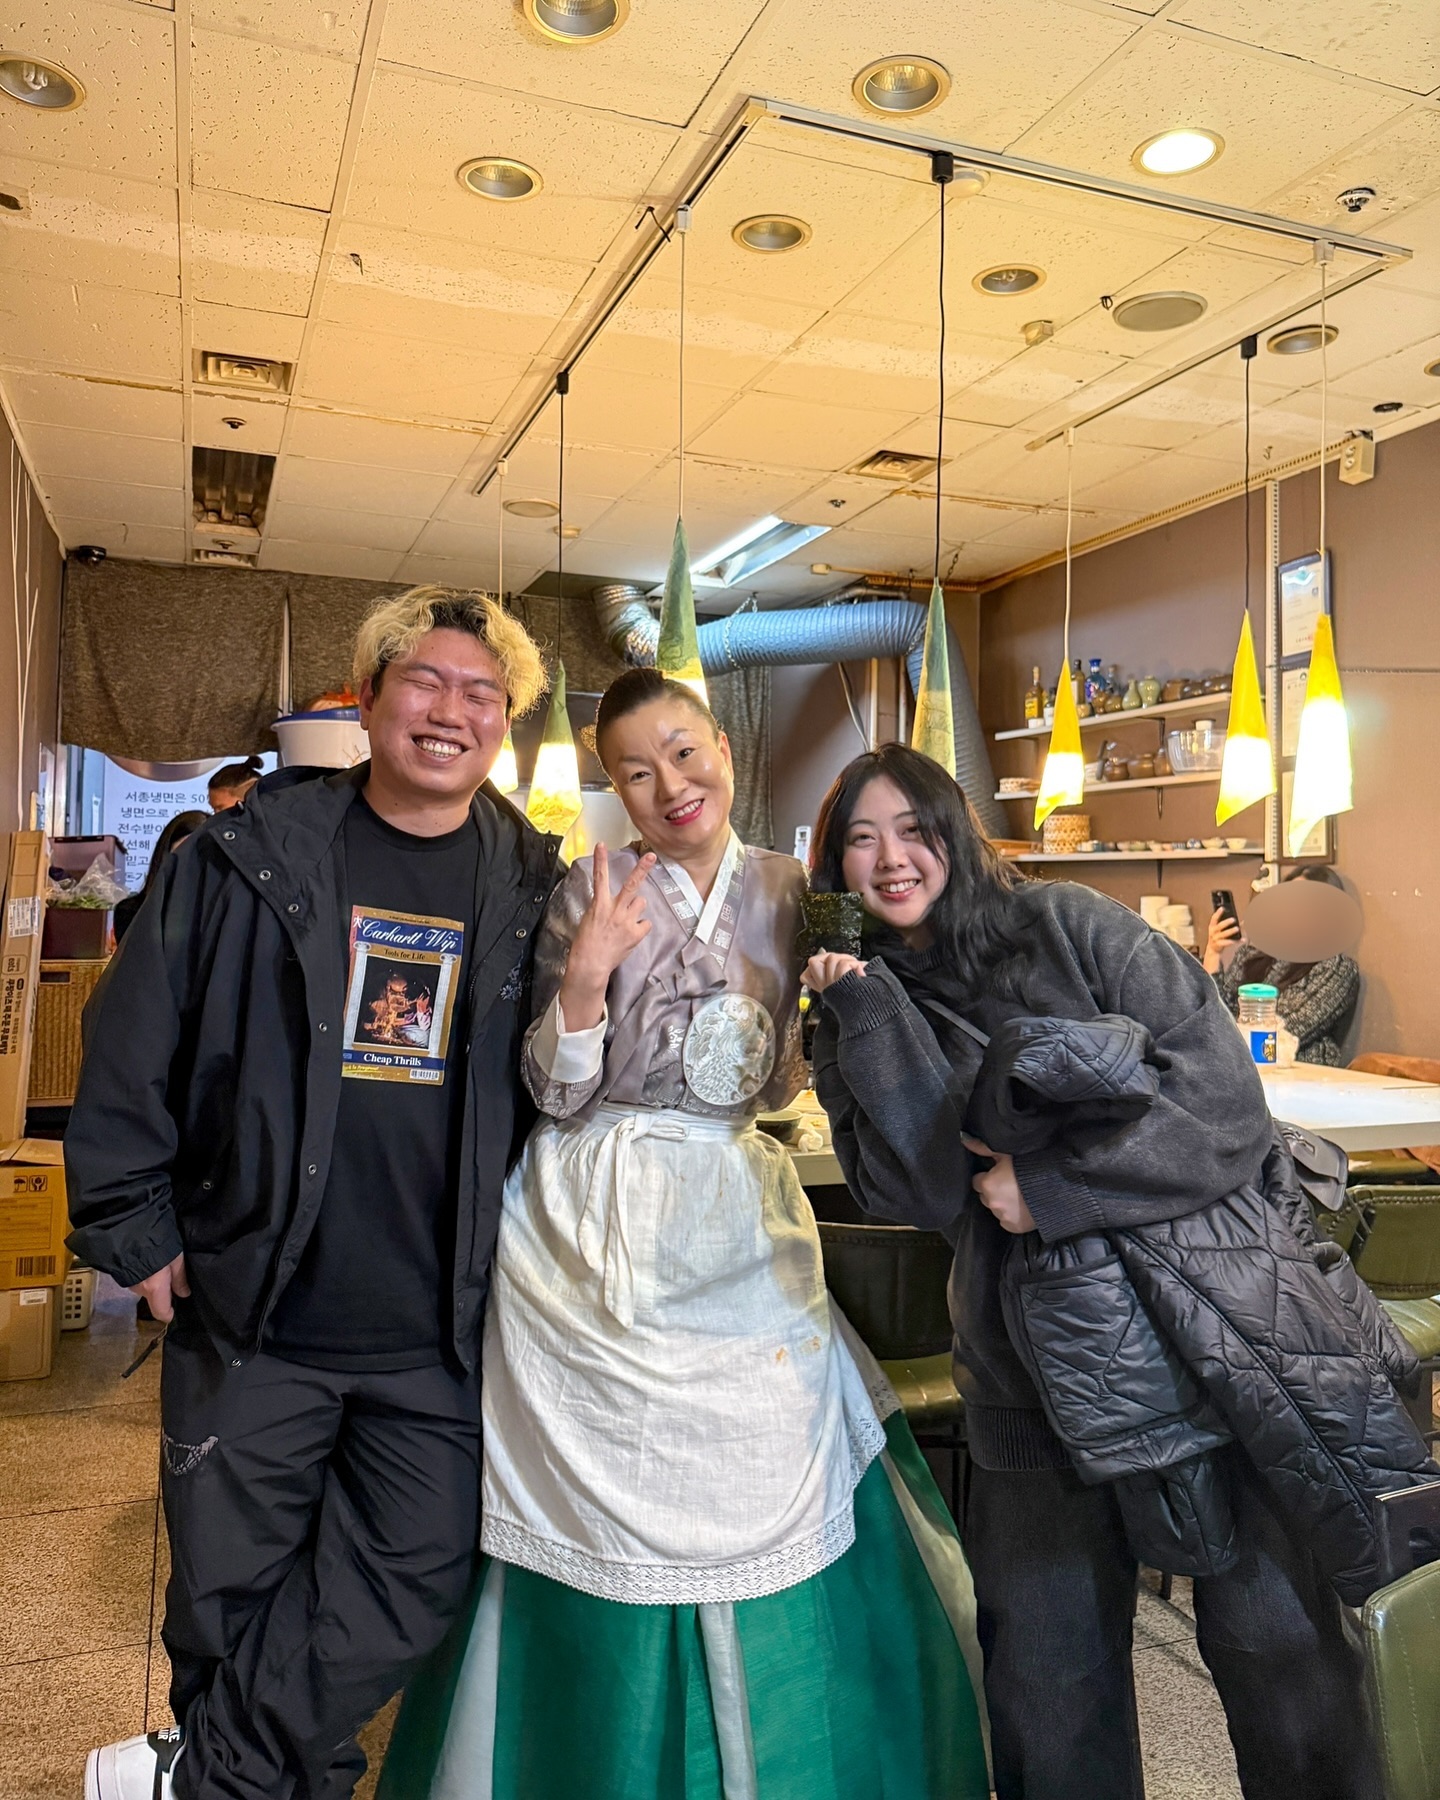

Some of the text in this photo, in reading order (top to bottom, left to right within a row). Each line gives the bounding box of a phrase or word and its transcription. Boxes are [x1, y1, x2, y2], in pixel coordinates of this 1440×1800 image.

[120, 807, 169, 818] 냉면으로
[362, 918, 423, 945] Carhartt
[384, 949, 425, 961] Tools for Life
[363, 1052, 392, 1066] Cheap
[393, 1055, 422, 1067] Thrills
